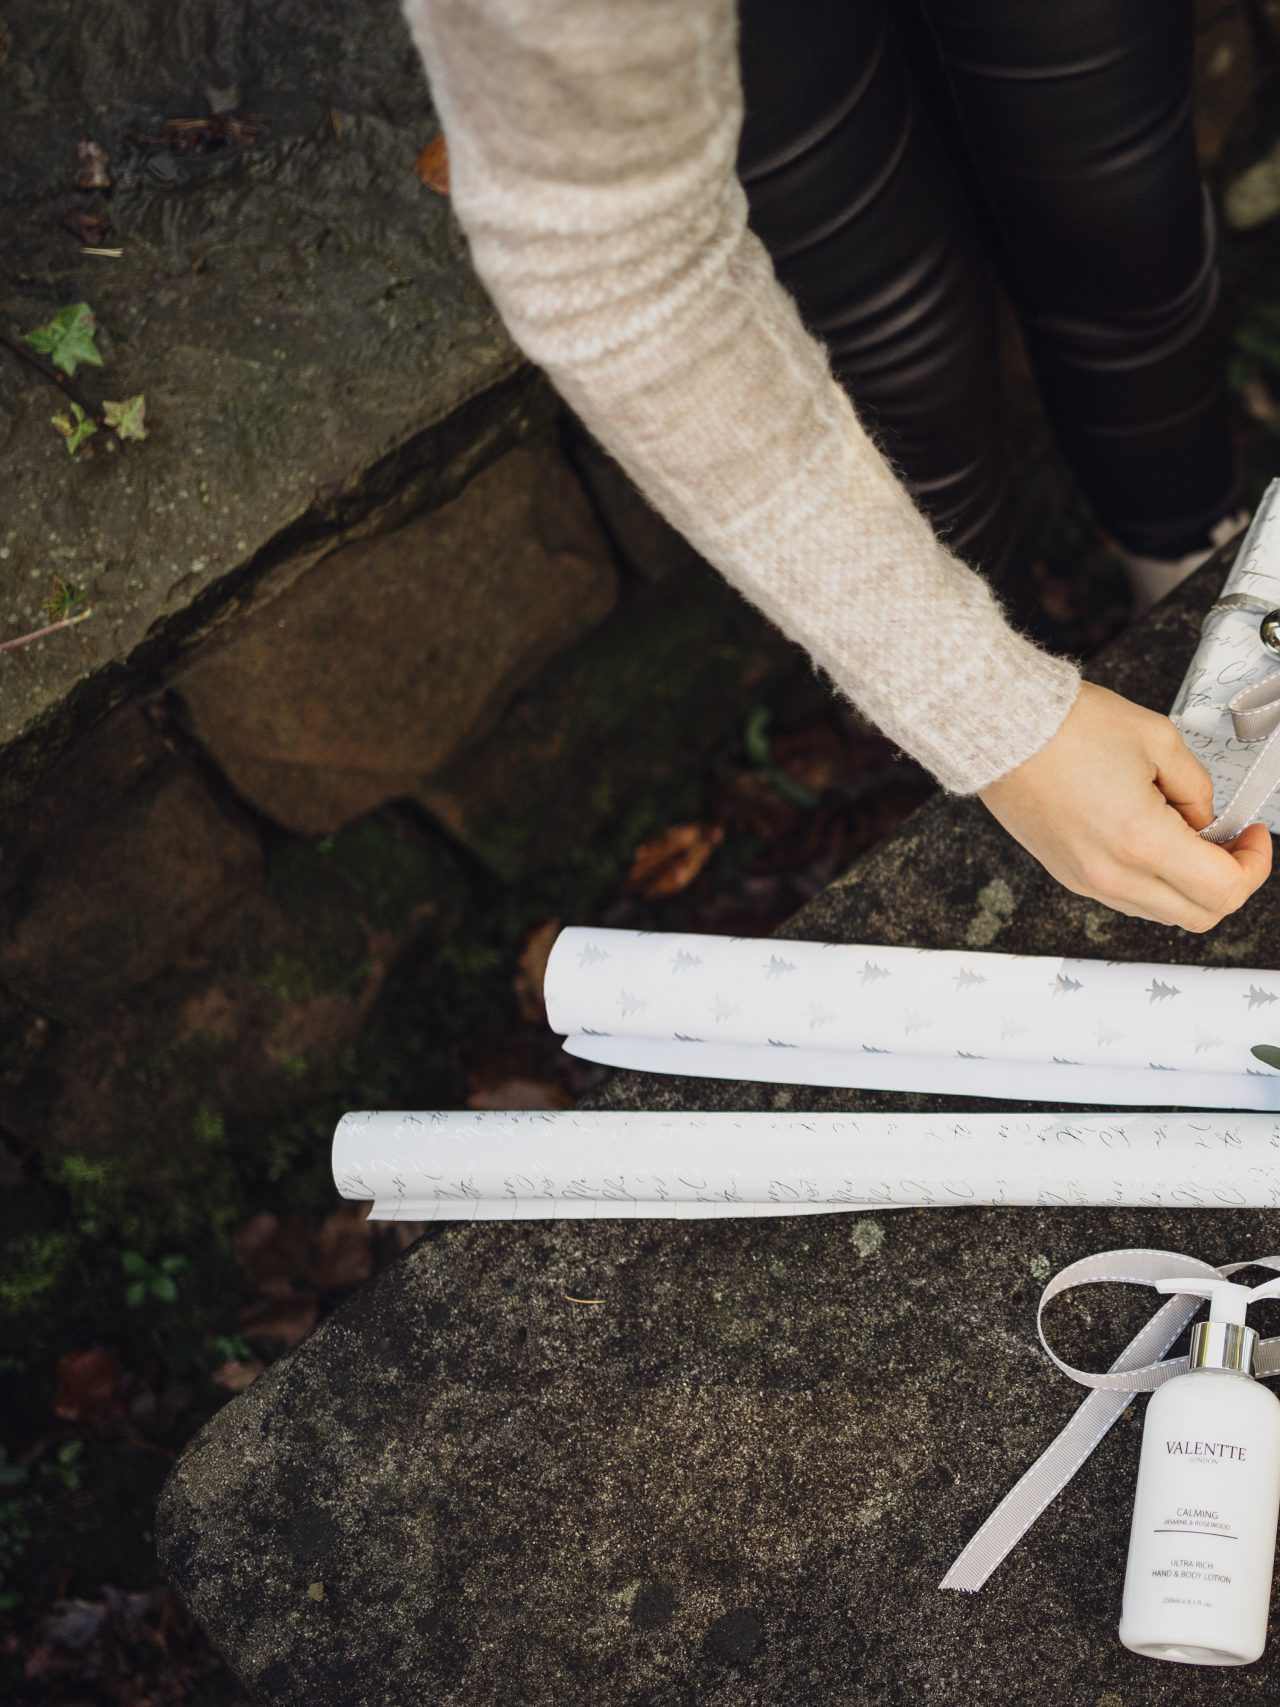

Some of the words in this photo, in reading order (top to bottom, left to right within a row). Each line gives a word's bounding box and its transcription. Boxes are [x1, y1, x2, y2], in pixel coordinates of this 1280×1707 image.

[1166, 1441, 1247, 1462] VALENTTE
[1189, 1457, 1218, 1465] LONDON
[1176, 1508, 1219, 1520] CALMING
[1170, 1559, 1194, 1568] ULTRA
[1195, 1561, 1214, 1569] RICH
[1152, 1569, 1172, 1577] HAND
[1180, 1571, 1202, 1579] BODY
[1203, 1573, 1232, 1584] LOTION
